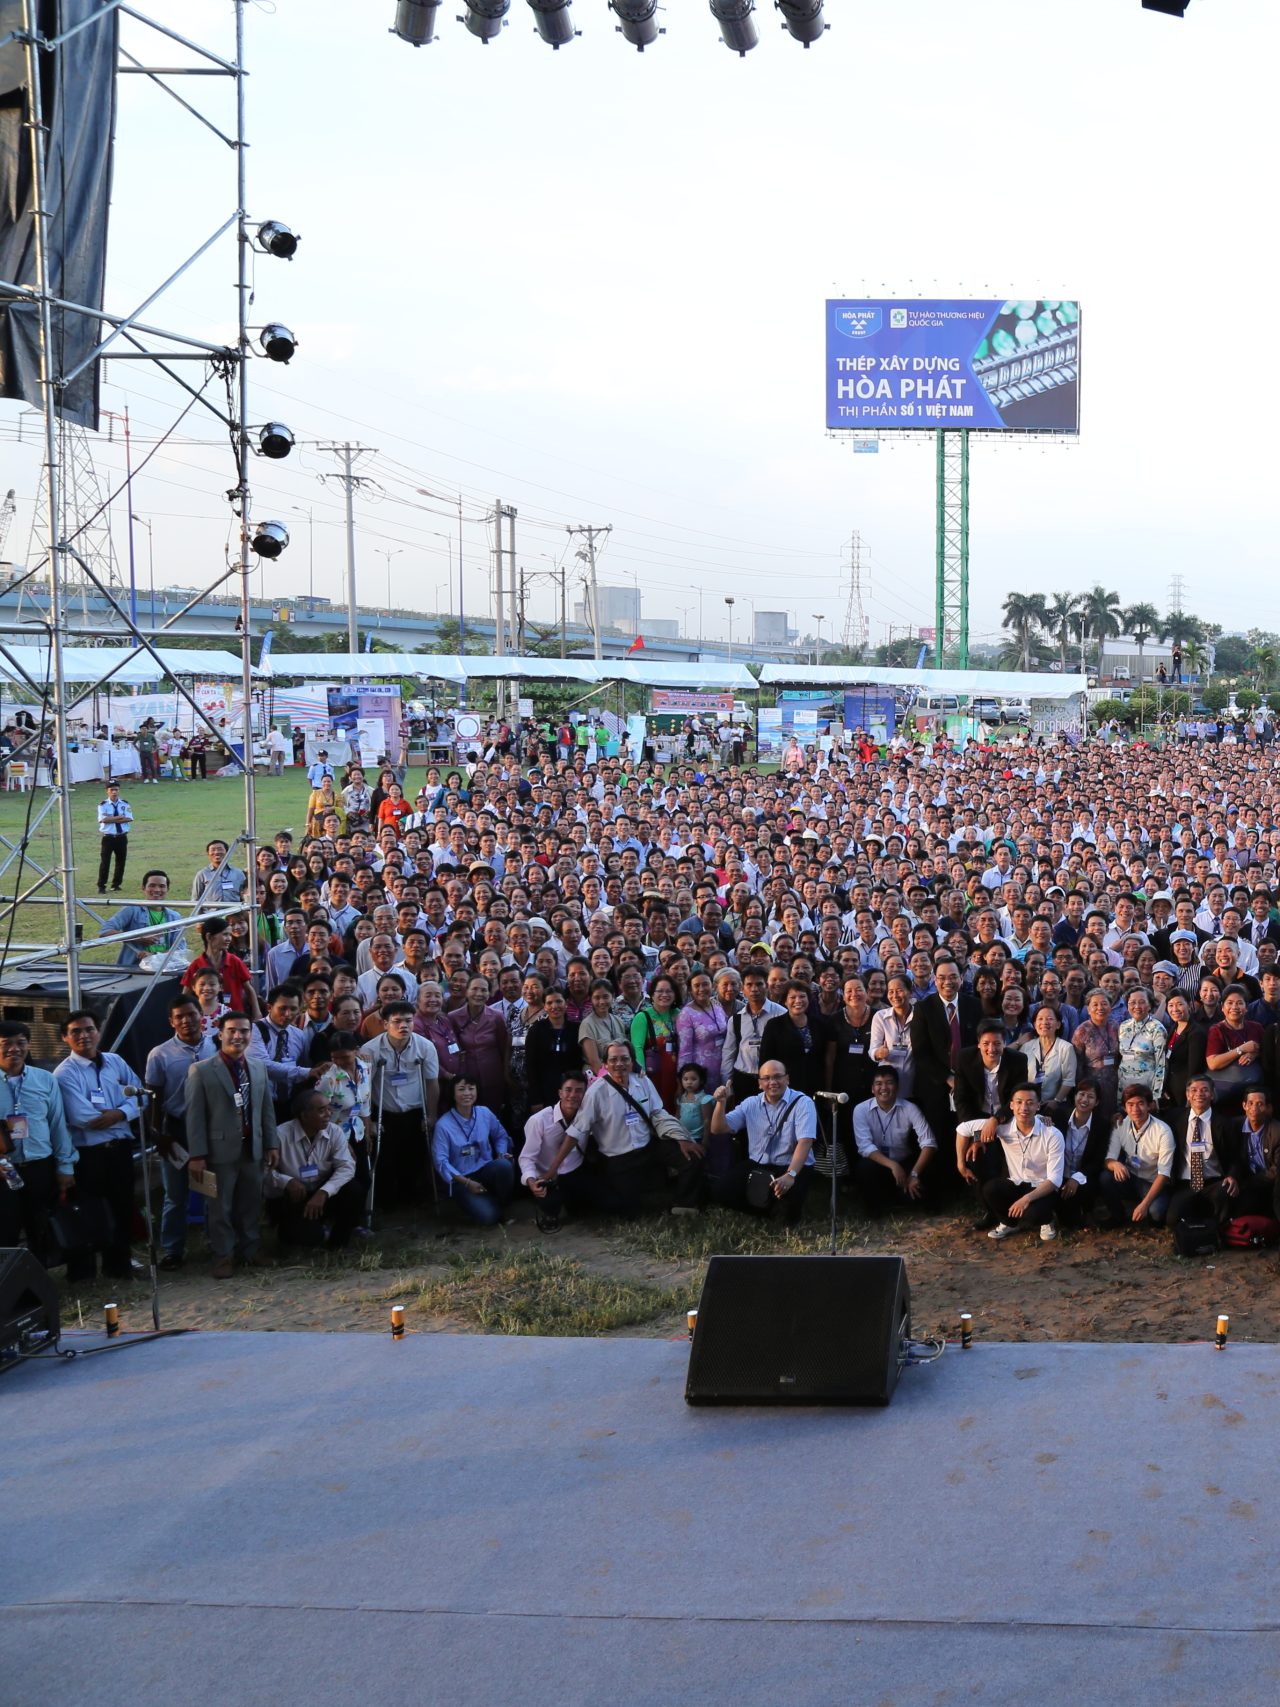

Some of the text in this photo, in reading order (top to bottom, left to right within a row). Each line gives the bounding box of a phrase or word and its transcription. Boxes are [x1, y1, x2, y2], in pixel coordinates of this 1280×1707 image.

[842, 311, 876, 319] HÒA PHÁT
[919, 311, 935, 319] HÀO
[937, 311, 967, 319] THƯƠNG
[968, 312, 985, 320] HIỆU
[908, 319, 930, 327] QUỐC
[836, 354, 960, 374] THÉP XÂY DỰNG
[837, 374, 967, 399] HÒA PHÁT
[838, 401, 974, 419] THỊ PHẦN SỐ 1 VIỆT NAM
